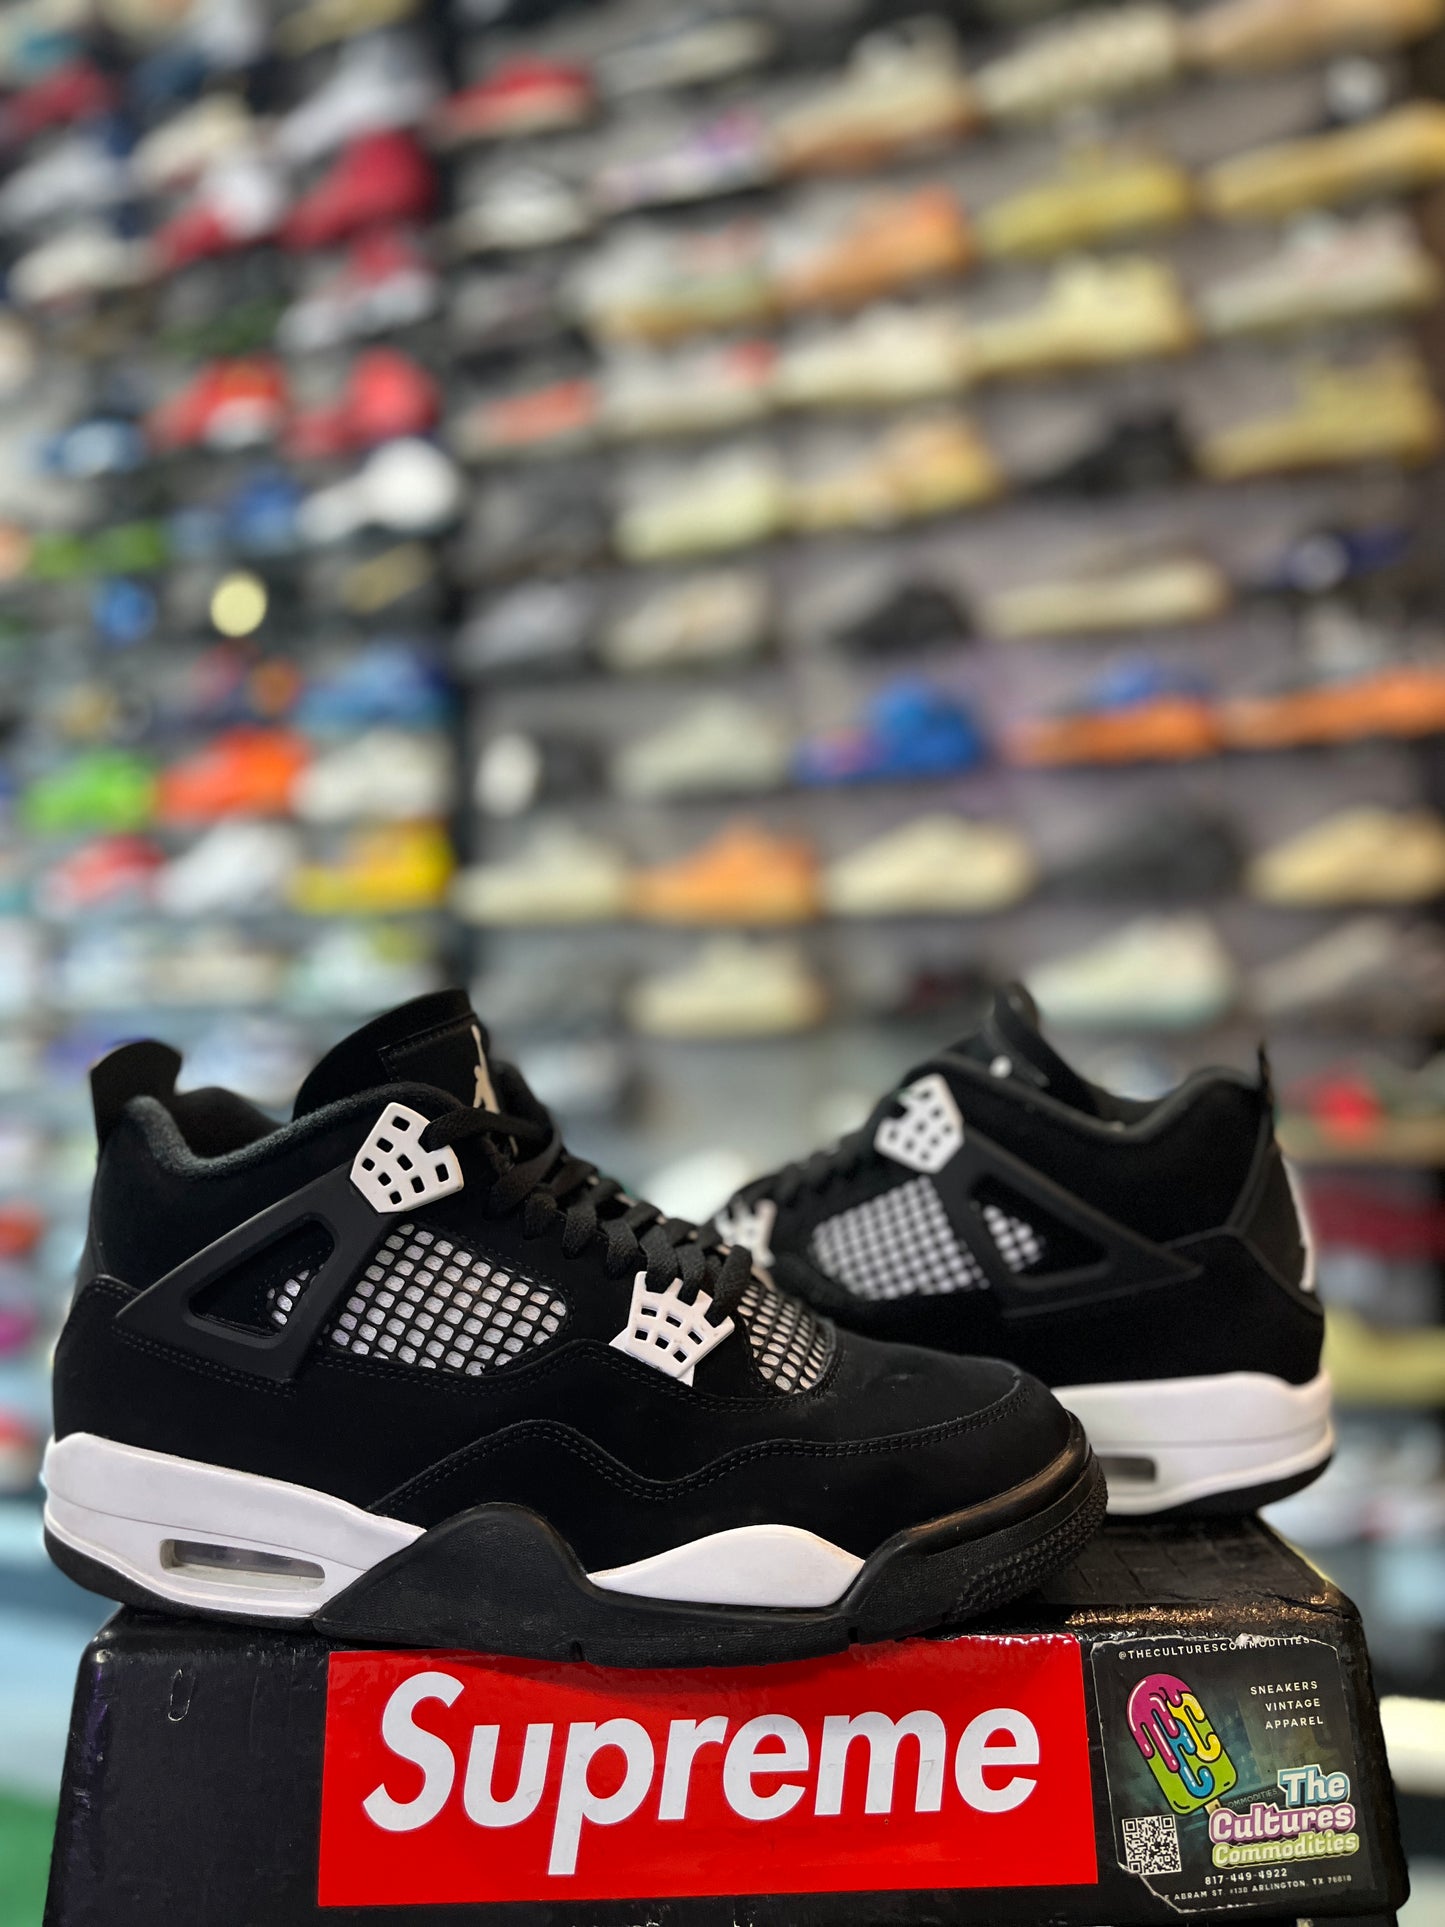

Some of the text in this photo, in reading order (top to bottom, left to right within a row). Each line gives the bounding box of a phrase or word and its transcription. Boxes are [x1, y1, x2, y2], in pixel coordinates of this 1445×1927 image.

[1250, 1680, 1318, 1695] SNEAKERS
[1265, 1698, 1321, 1712] VINTAGE
[1265, 1716, 1324, 1730] APPAREL
[363, 1671, 1040, 1876] Supreme
[1282, 1769, 1346, 1802] The
[1226, 1788, 1279, 1809] OMMODITIES
[1212, 1805, 1352, 1841] Cultures
[1215, 1832, 1357, 1865] Commodities
[1204, 1868, 1288, 1886] 817-449-4922
[1174, 1890, 1208, 1901] ABRAM
[1312, 1878, 1324, 1886] TX
